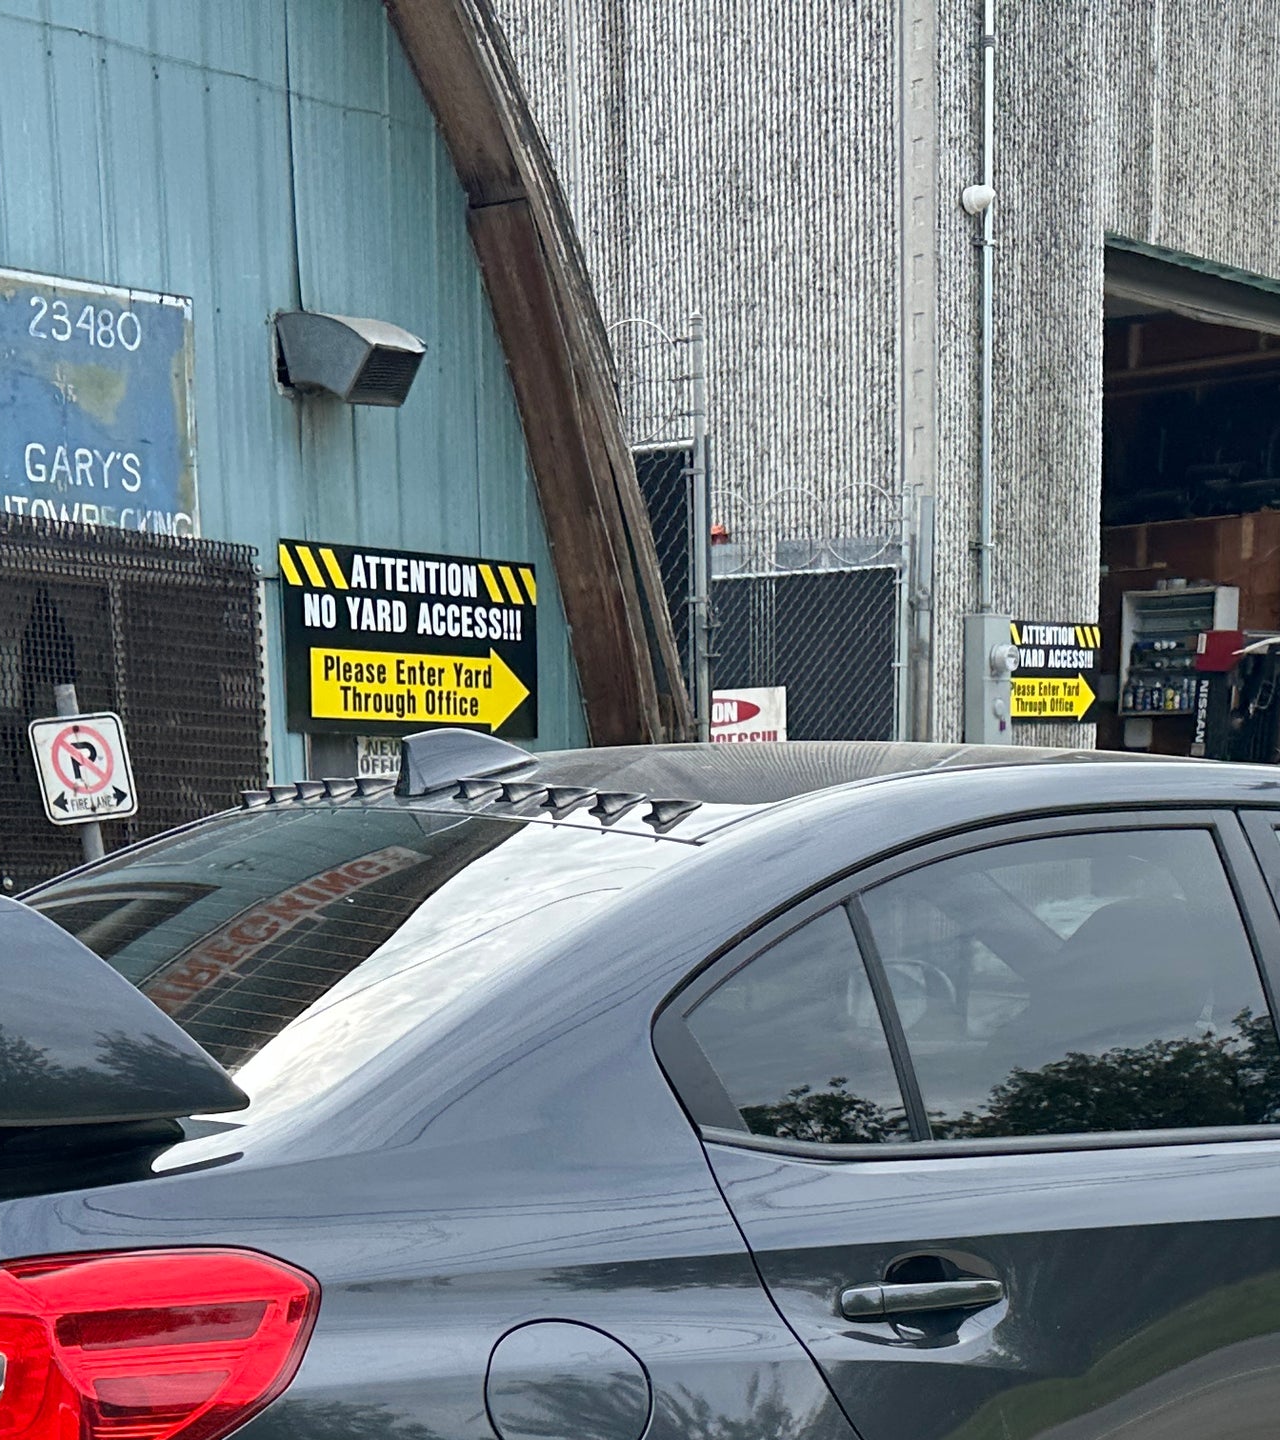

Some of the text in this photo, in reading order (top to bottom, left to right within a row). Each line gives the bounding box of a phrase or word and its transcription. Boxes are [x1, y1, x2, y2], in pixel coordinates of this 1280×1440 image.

[28, 295, 143, 351] 23480
[24, 443, 142, 492] GARY'S
[350, 554, 478, 598] ATTENTION
[304, 593, 522, 641] NO YARD ACCESS!!!
[1021, 625, 1076, 646] ATTENTION
[323, 655, 493, 690] Please Enter Yard
[1019, 648, 1094, 669] YARD ACCESS!!!
[339, 686, 479, 718] Through Office
[1038, 681, 1060, 697] Enter
[1062, 681, 1080, 697] Yard
[1015, 697, 1074, 715] Through Office
[1195, 680, 1209, 742] NISSAN
[70, 797, 90, 812] FIRE
